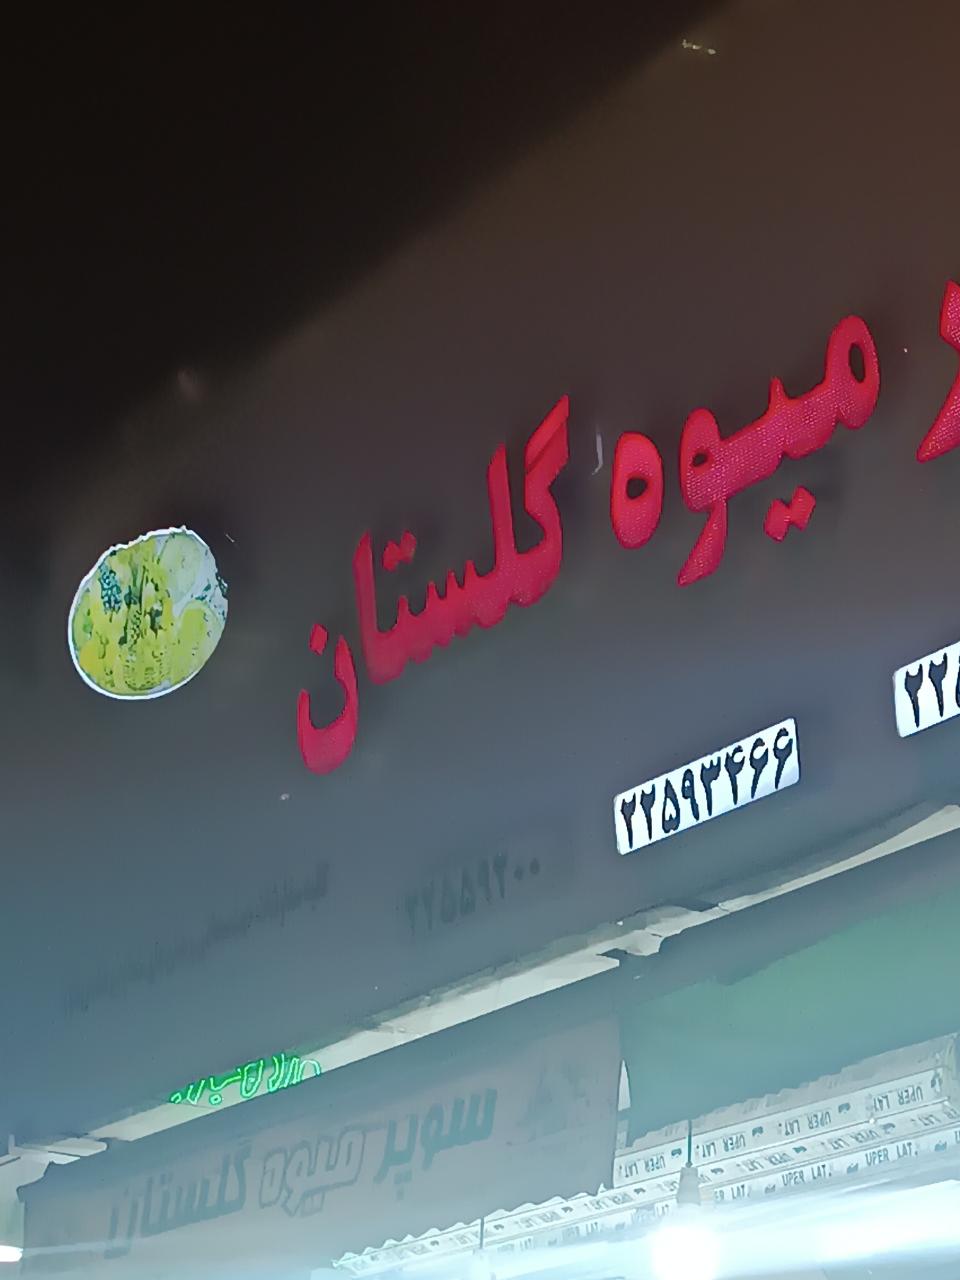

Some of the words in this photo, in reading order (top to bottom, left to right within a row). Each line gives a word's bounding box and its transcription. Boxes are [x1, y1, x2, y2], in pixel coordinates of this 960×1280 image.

[297, 394, 571, 777] گلستان
[610, 315, 880, 586] میوه
[620, 727, 794, 850] ۲۲۵۹۳۴۶۶
